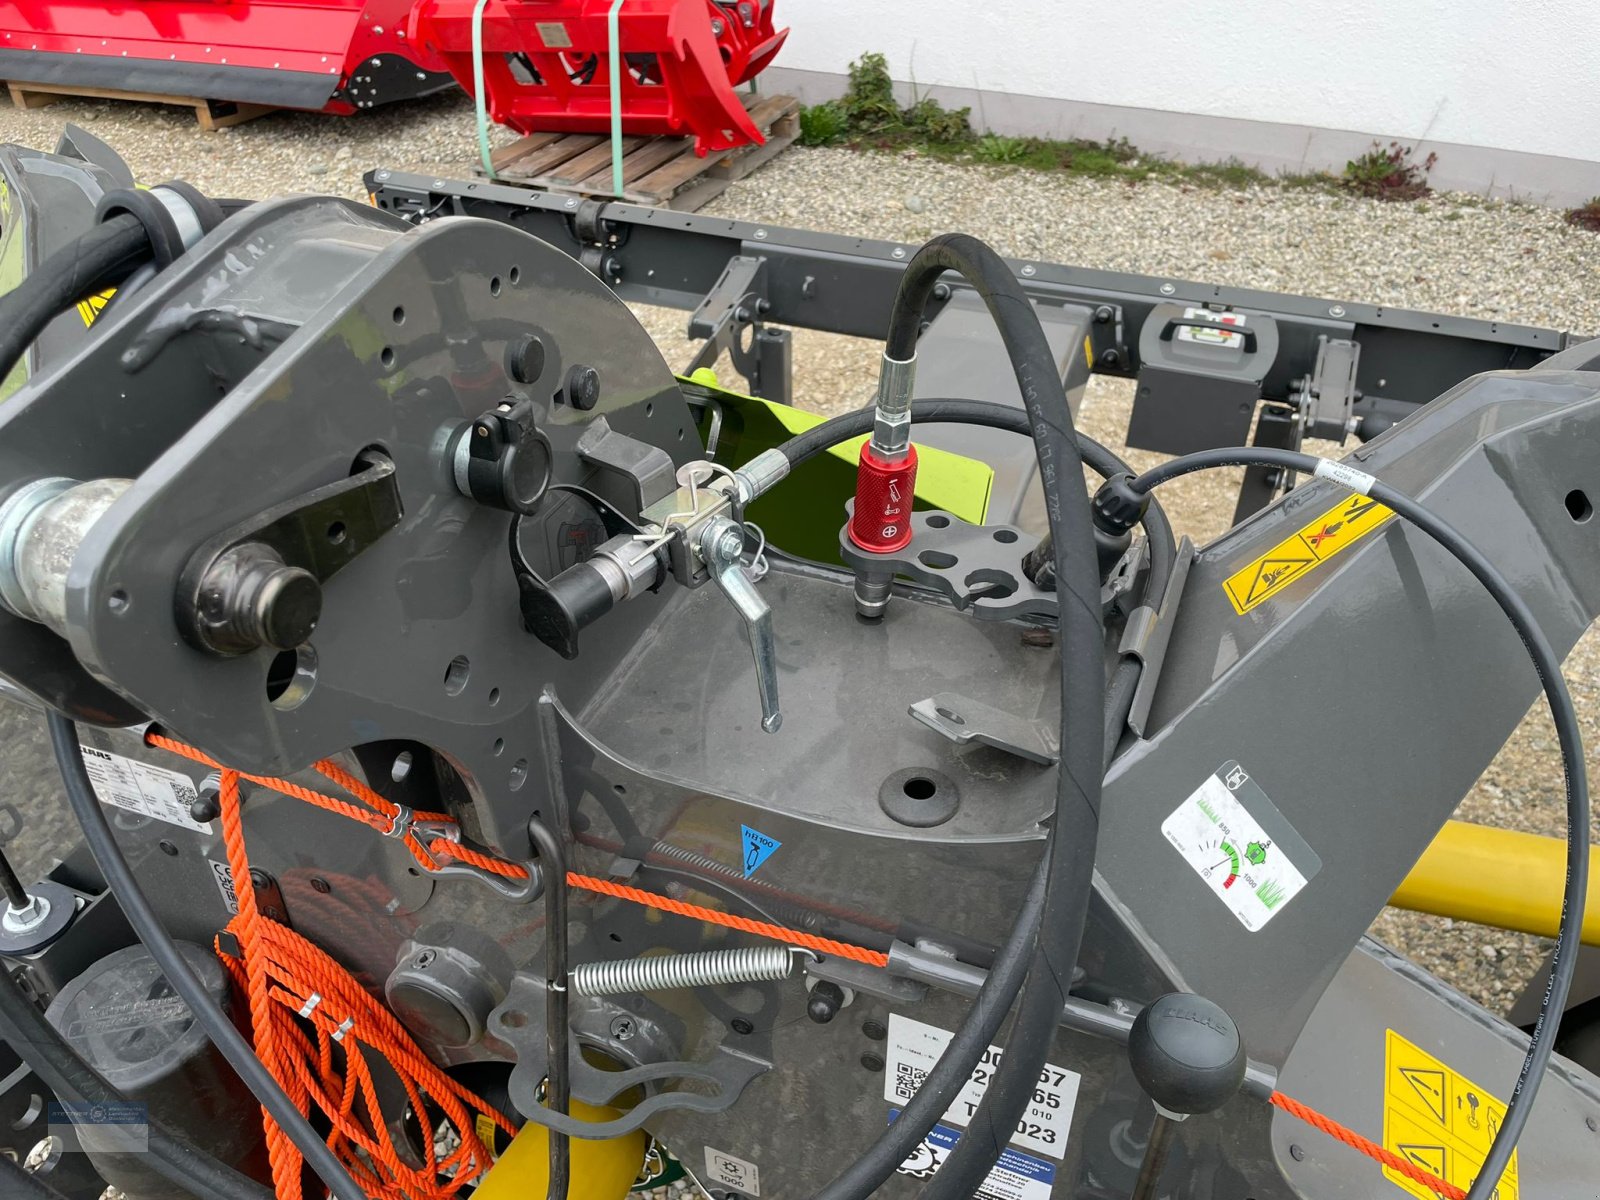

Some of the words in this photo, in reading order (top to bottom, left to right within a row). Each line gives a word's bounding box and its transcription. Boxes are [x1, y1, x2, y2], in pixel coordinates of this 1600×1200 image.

[80, 748, 112, 761] LAAS
[1218, 822, 1231, 836] 850
[1244, 872, 1257, 889] 1000
[1032, 1108, 1053, 1121] 010
[720, 1174, 745, 1188] 1000
